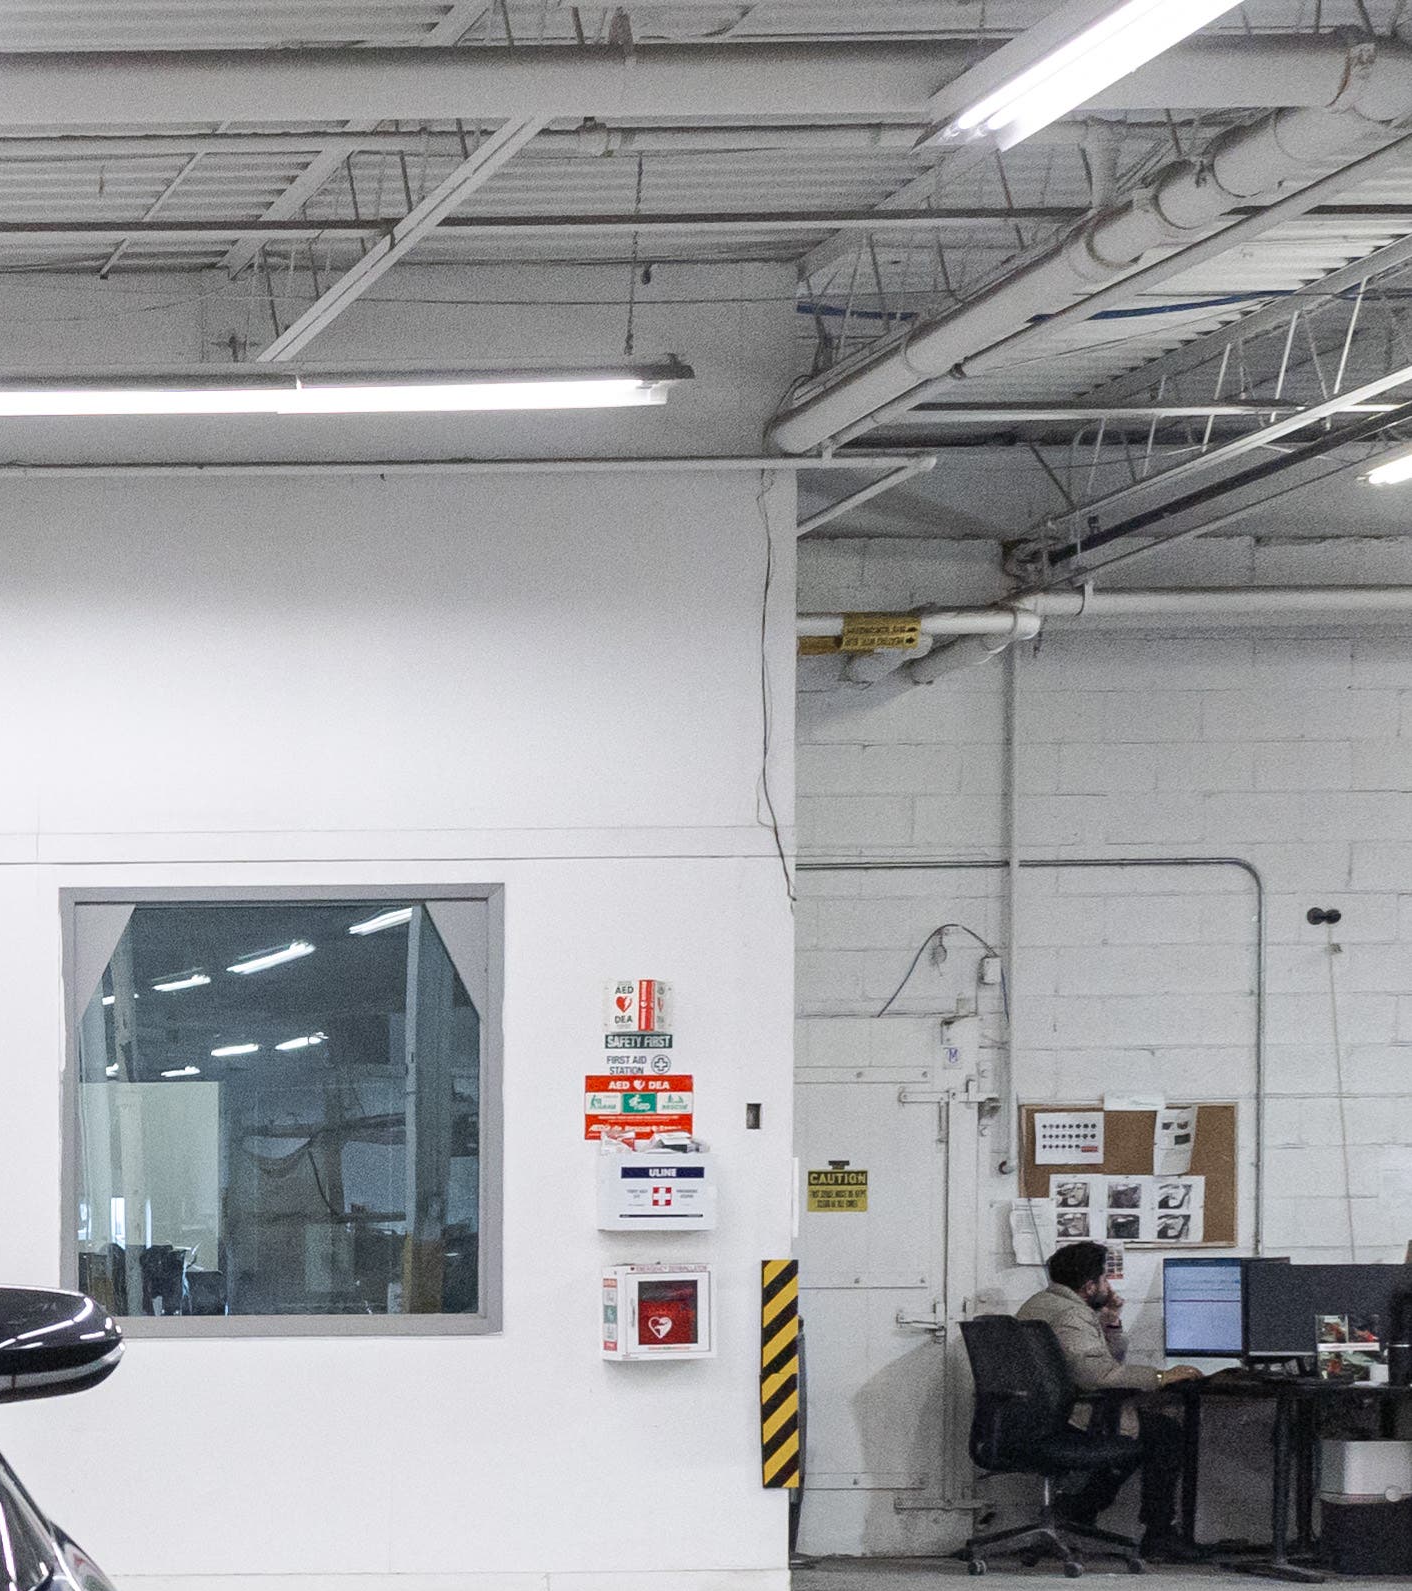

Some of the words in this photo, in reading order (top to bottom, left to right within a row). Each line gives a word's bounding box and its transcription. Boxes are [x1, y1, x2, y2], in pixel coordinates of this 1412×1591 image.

[614, 986, 634, 994] AED
[614, 1015, 633, 1024] DEA
[607, 1036, 641, 1048] SAFETY
[644, 1036, 671, 1048] FIRST
[606, 1055, 630, 1064] FIRST
[632, 1055, 647, 1064] AID
[609, 1066, 644, 1075] STATION
[608, 1081, 630, 1089] AED
[648, 1081, 670, 1089] DEA
[649, 1168, 677, 1177] ULINE
[809, 1173, 866, 1184] CAUTION
